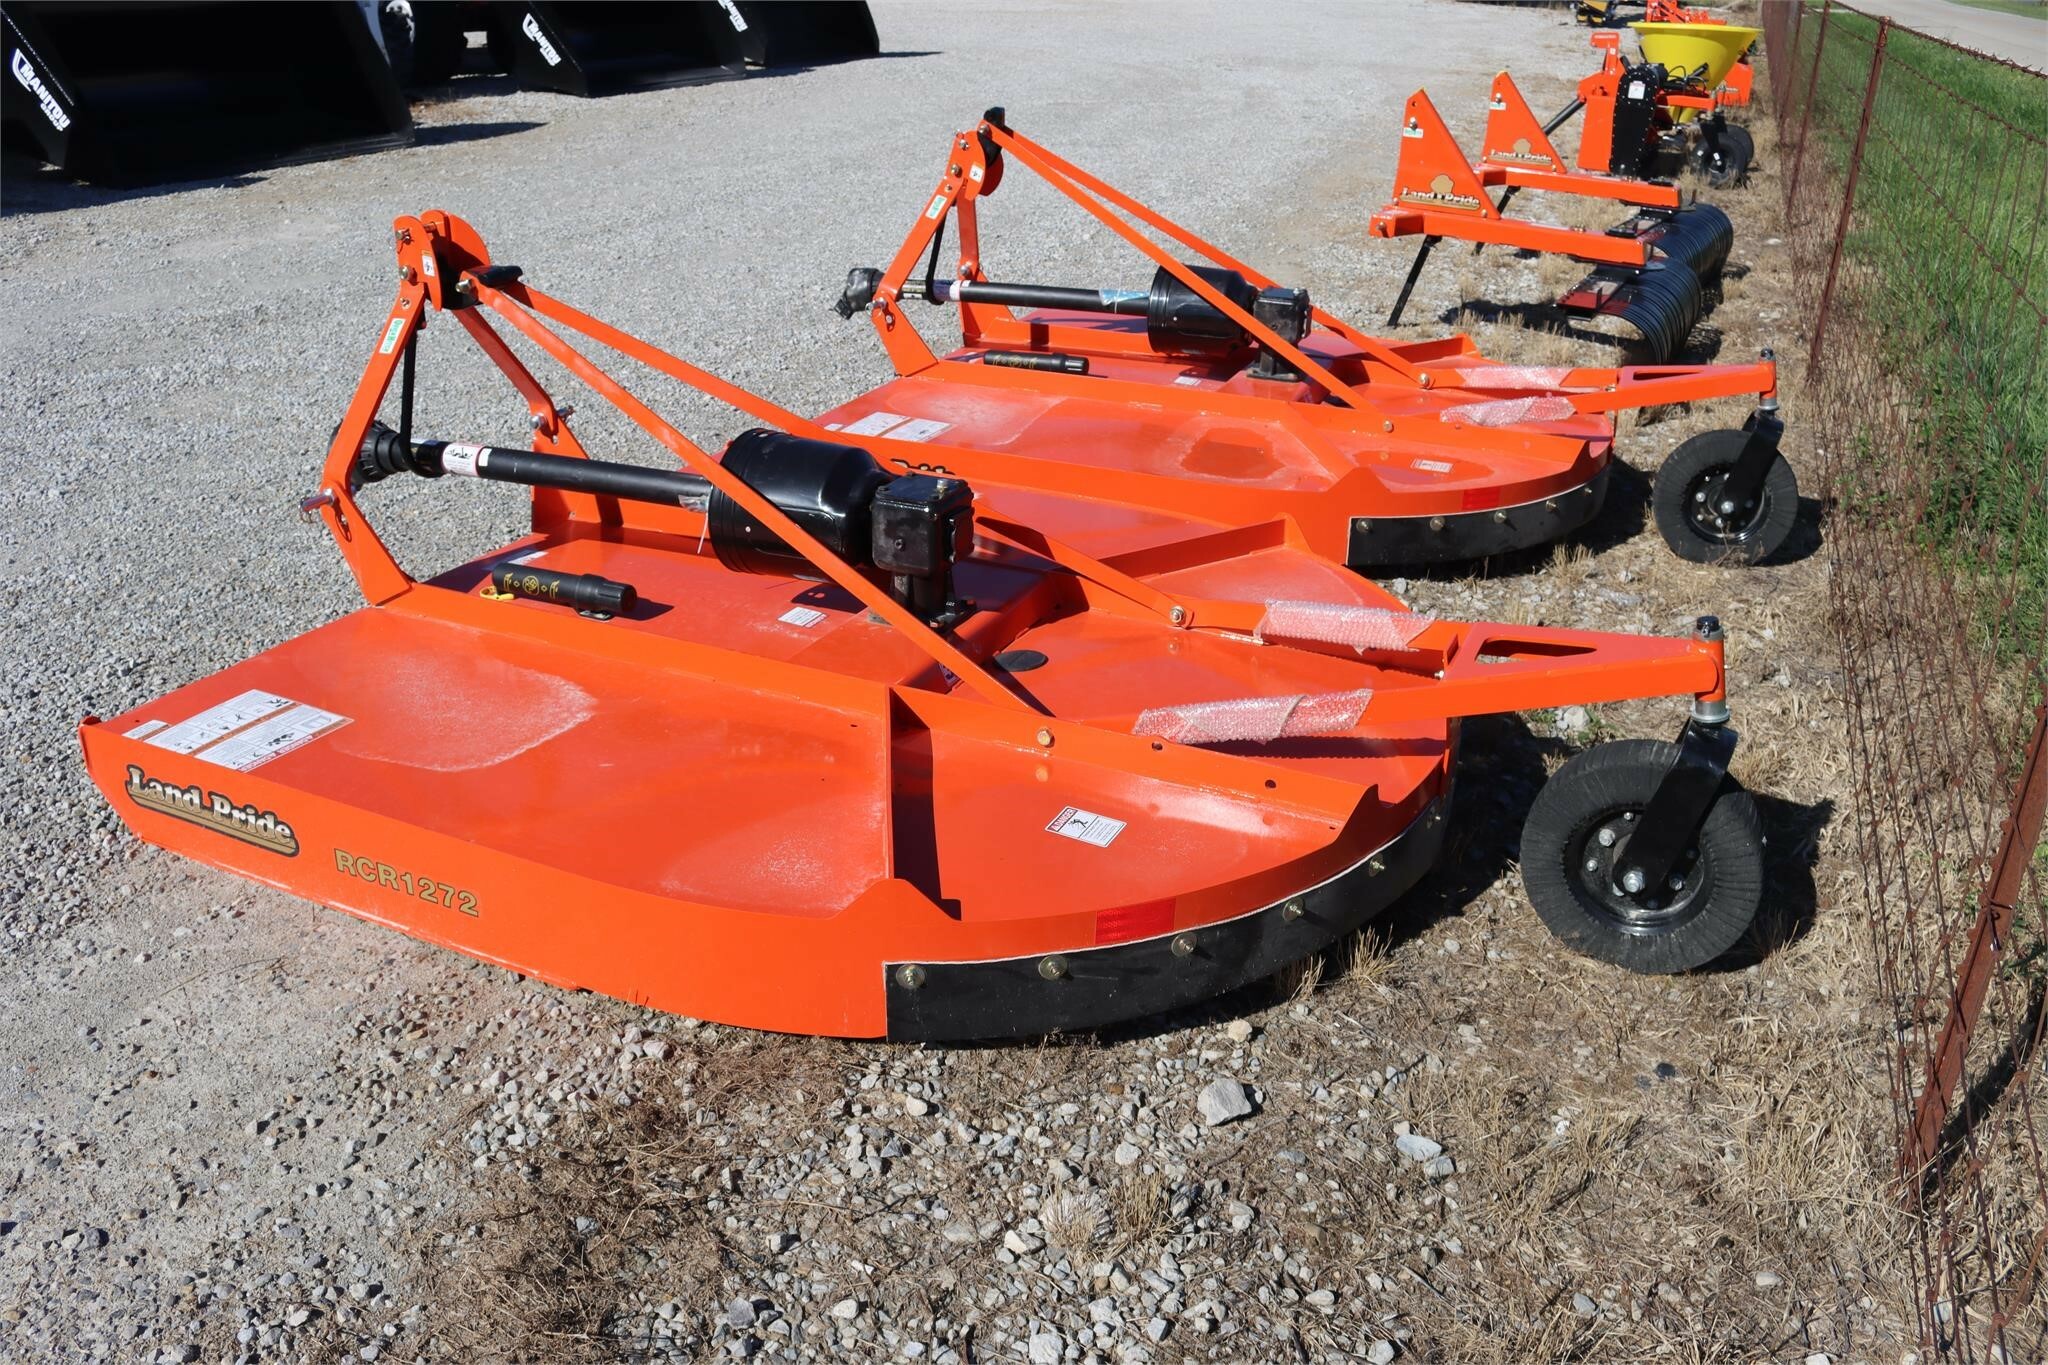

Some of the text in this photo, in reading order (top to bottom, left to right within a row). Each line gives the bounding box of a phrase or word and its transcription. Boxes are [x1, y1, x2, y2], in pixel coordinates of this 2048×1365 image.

[20, 63, 71, 128] MANITOU
[1402, 186, 1480, 207] Land Pride
[127, 765, 296, 845] Land Pride
[334, 848, 479, 917] RCR1272
